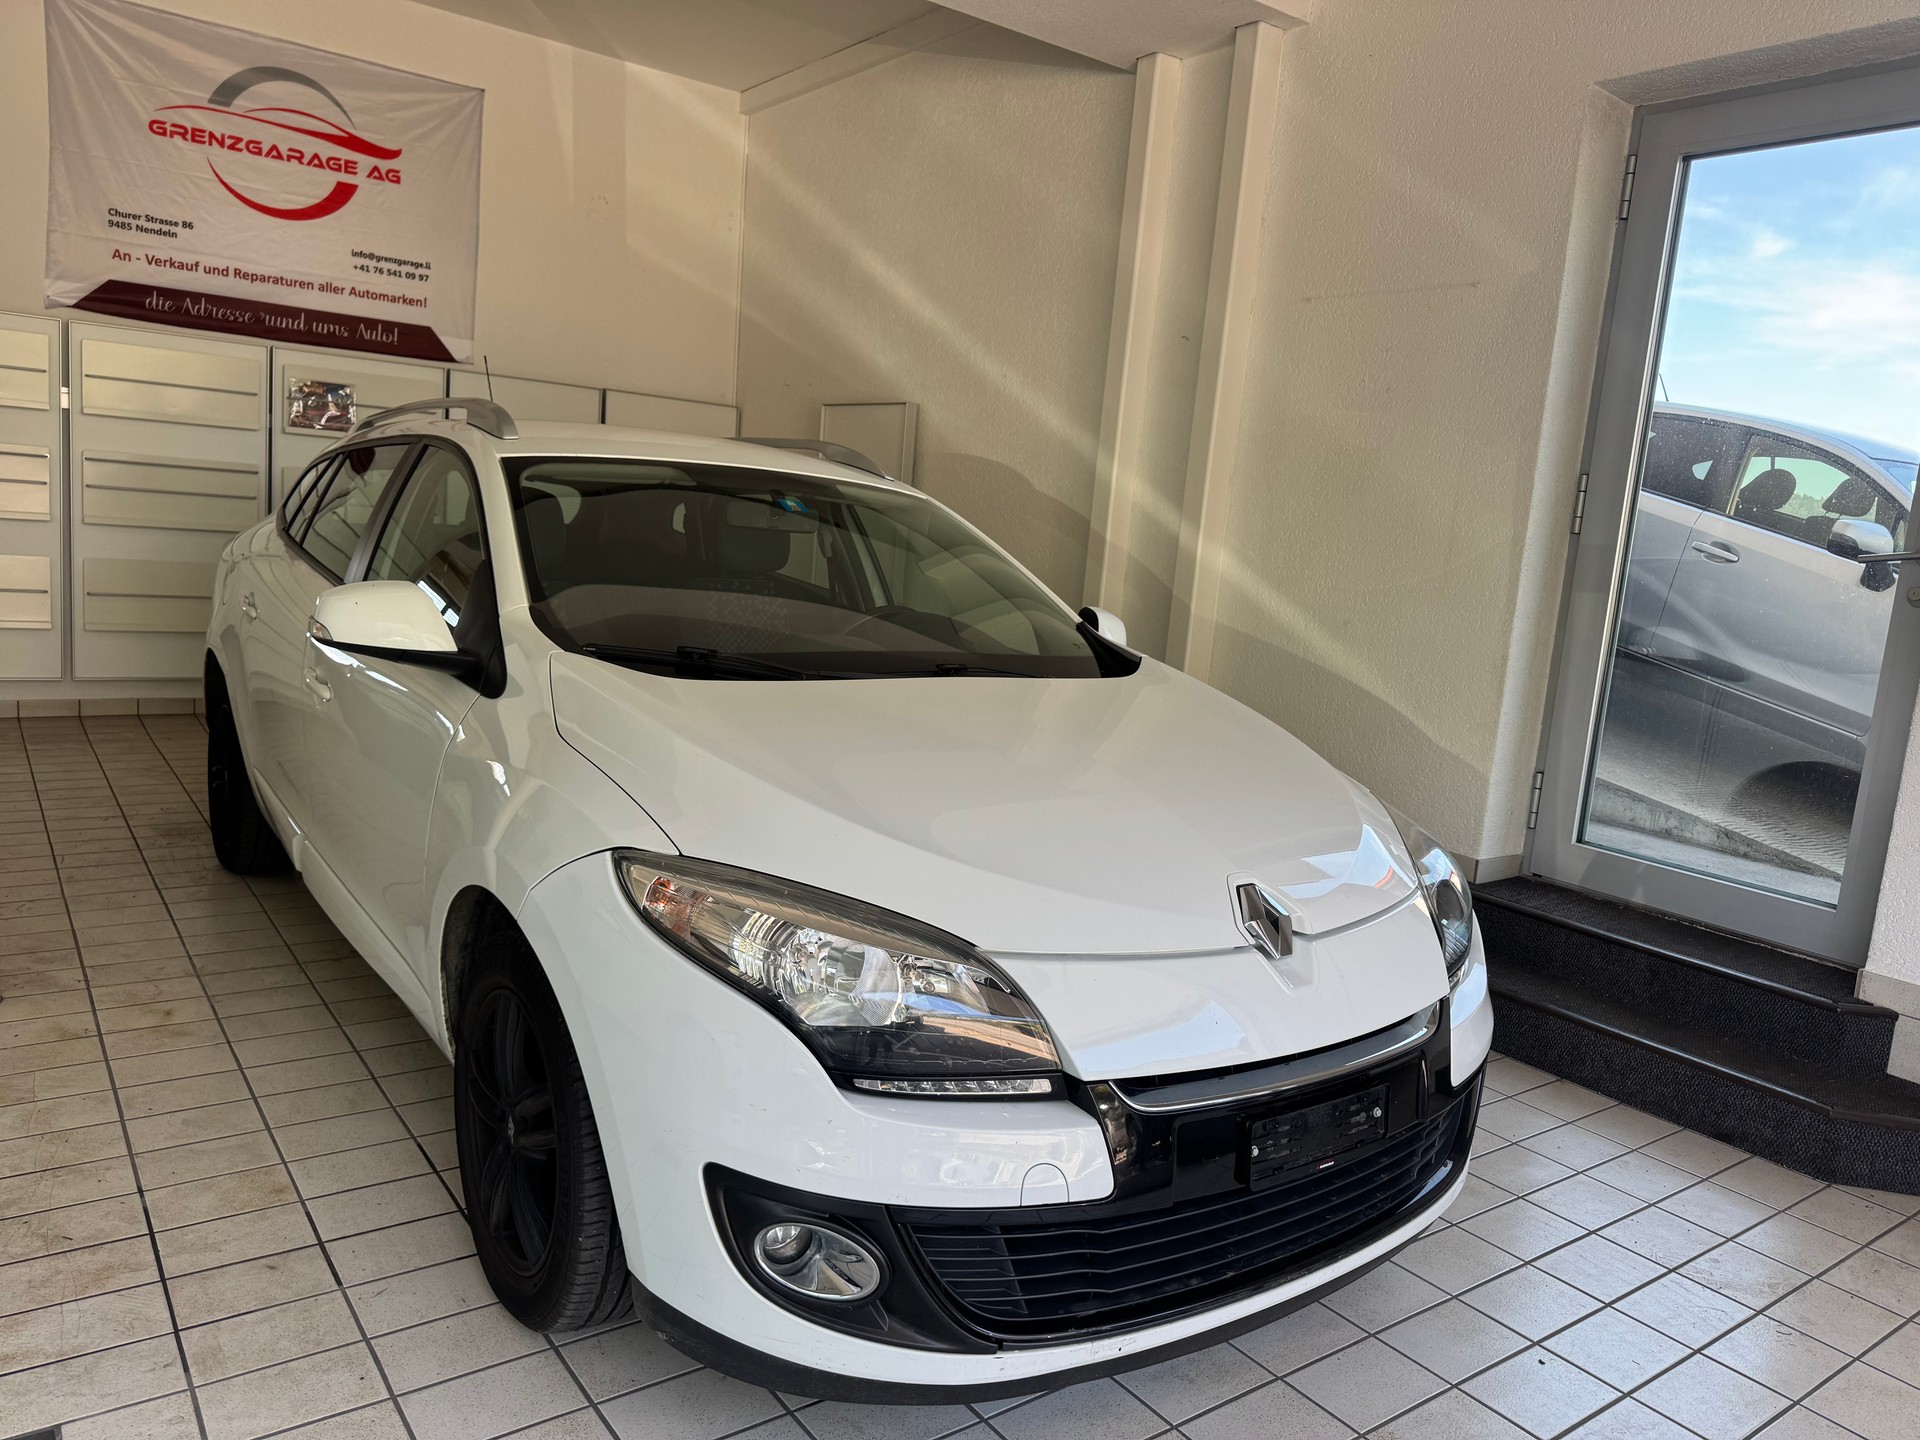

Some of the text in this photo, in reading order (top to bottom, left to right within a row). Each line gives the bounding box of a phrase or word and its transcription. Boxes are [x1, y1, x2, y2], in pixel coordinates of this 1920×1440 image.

[148, 119, 402, 184] GRENZGARAGE AG
[108, 208, 194, 230] Churer Strasse 86
[108, 219, 178, 238] 9485 Nendeln
[351, 249, 431, 270] info@grenzgarage.li
[112, 249, 131, 262] An
[145, 254, 200, 272] Verkauf
[203, 265, 229, 277] und
[233, 268, 314, 290] Reparaturen
[318, 282, 346, 295] aller
[348, 286, 427, 308] Automarken!
[353, 263, 429, 282] +41 76 541 09 97
[145, 290, 175, 312] die
[181, 297, 255, 323] Adresse
[260, 312, 308, 332] rund
[312, 320, 349, 337] ums
